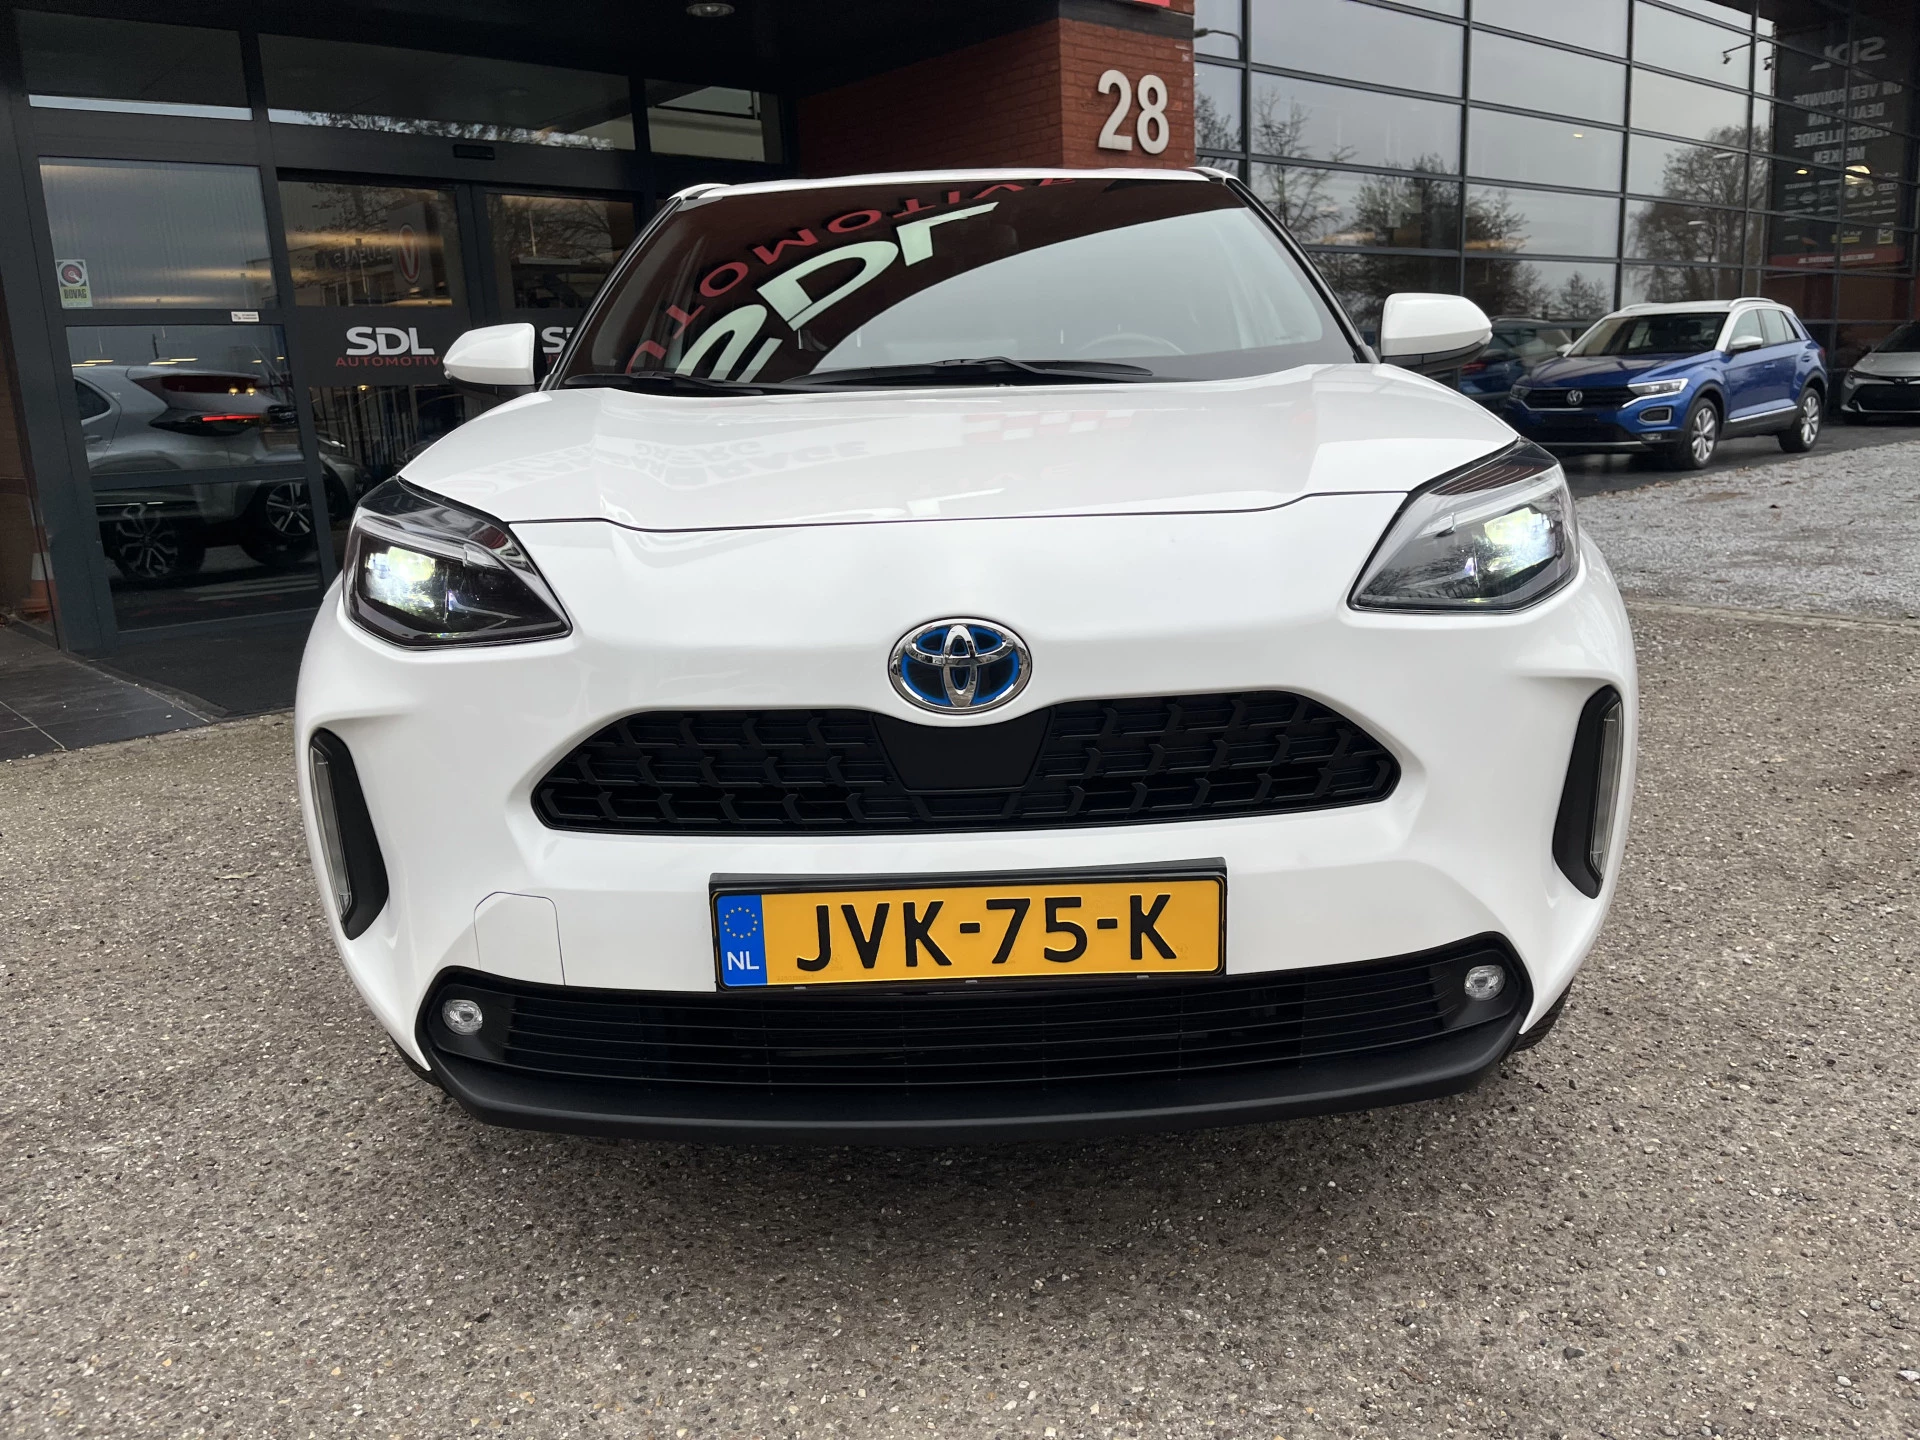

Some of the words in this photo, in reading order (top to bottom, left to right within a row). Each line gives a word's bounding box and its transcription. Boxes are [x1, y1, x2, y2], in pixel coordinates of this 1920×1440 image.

[1097, 69, 1170, 155] 28
[63, 288, 88, 299] BOVAG
[345, 326, 435, 355] SDL
[335, 356, 440, 367] AUTOMOTIV
[797, 894, 1177, 971] JVK-75-K
[727, 951, 760, 970] NL
